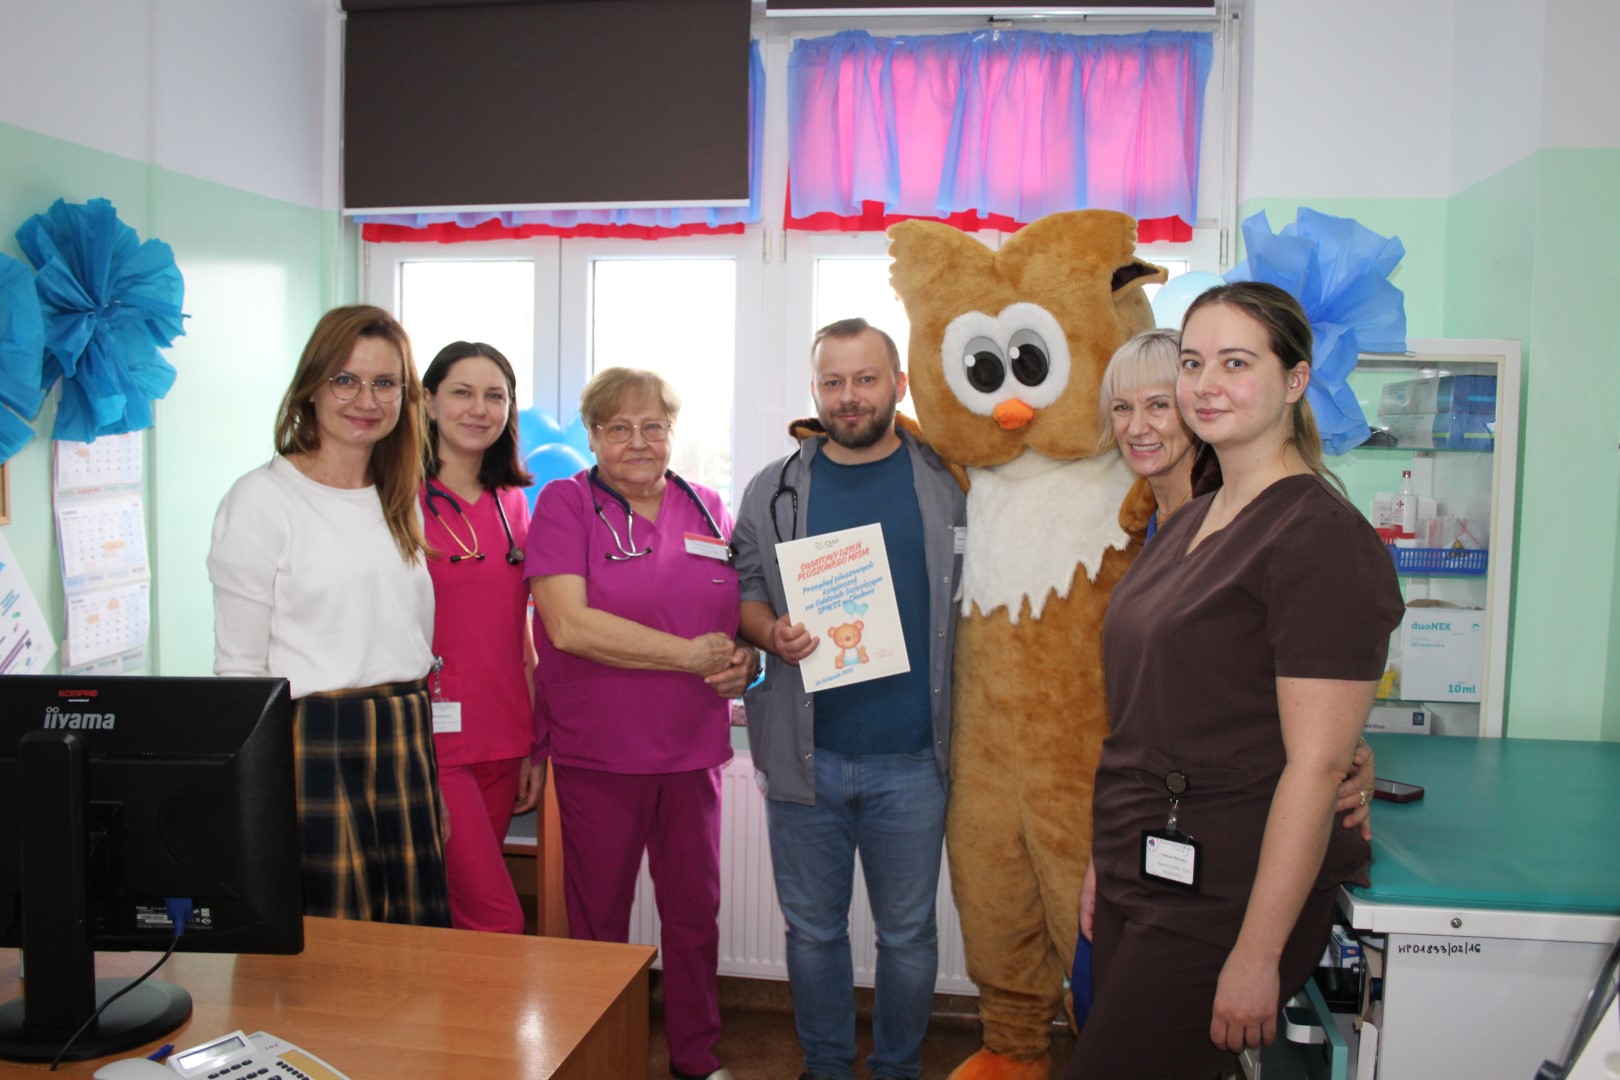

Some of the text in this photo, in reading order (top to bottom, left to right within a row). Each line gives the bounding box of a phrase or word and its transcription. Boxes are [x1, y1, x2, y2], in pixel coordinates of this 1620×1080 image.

[797, 547, 870, 582] PLUSZOWEGO MISIA
[800, 539, 862, 572] ŚWIATOWY DZIEŃ
[834, 561, 874, 583] pluszowych
[1411, 622, 1451, 631] duoNEX
[58, 689, 98, 697] KOMPRE
[1448, 684, 1476, 693] 10 ml
[43, 706, 116, 729] iiyama
